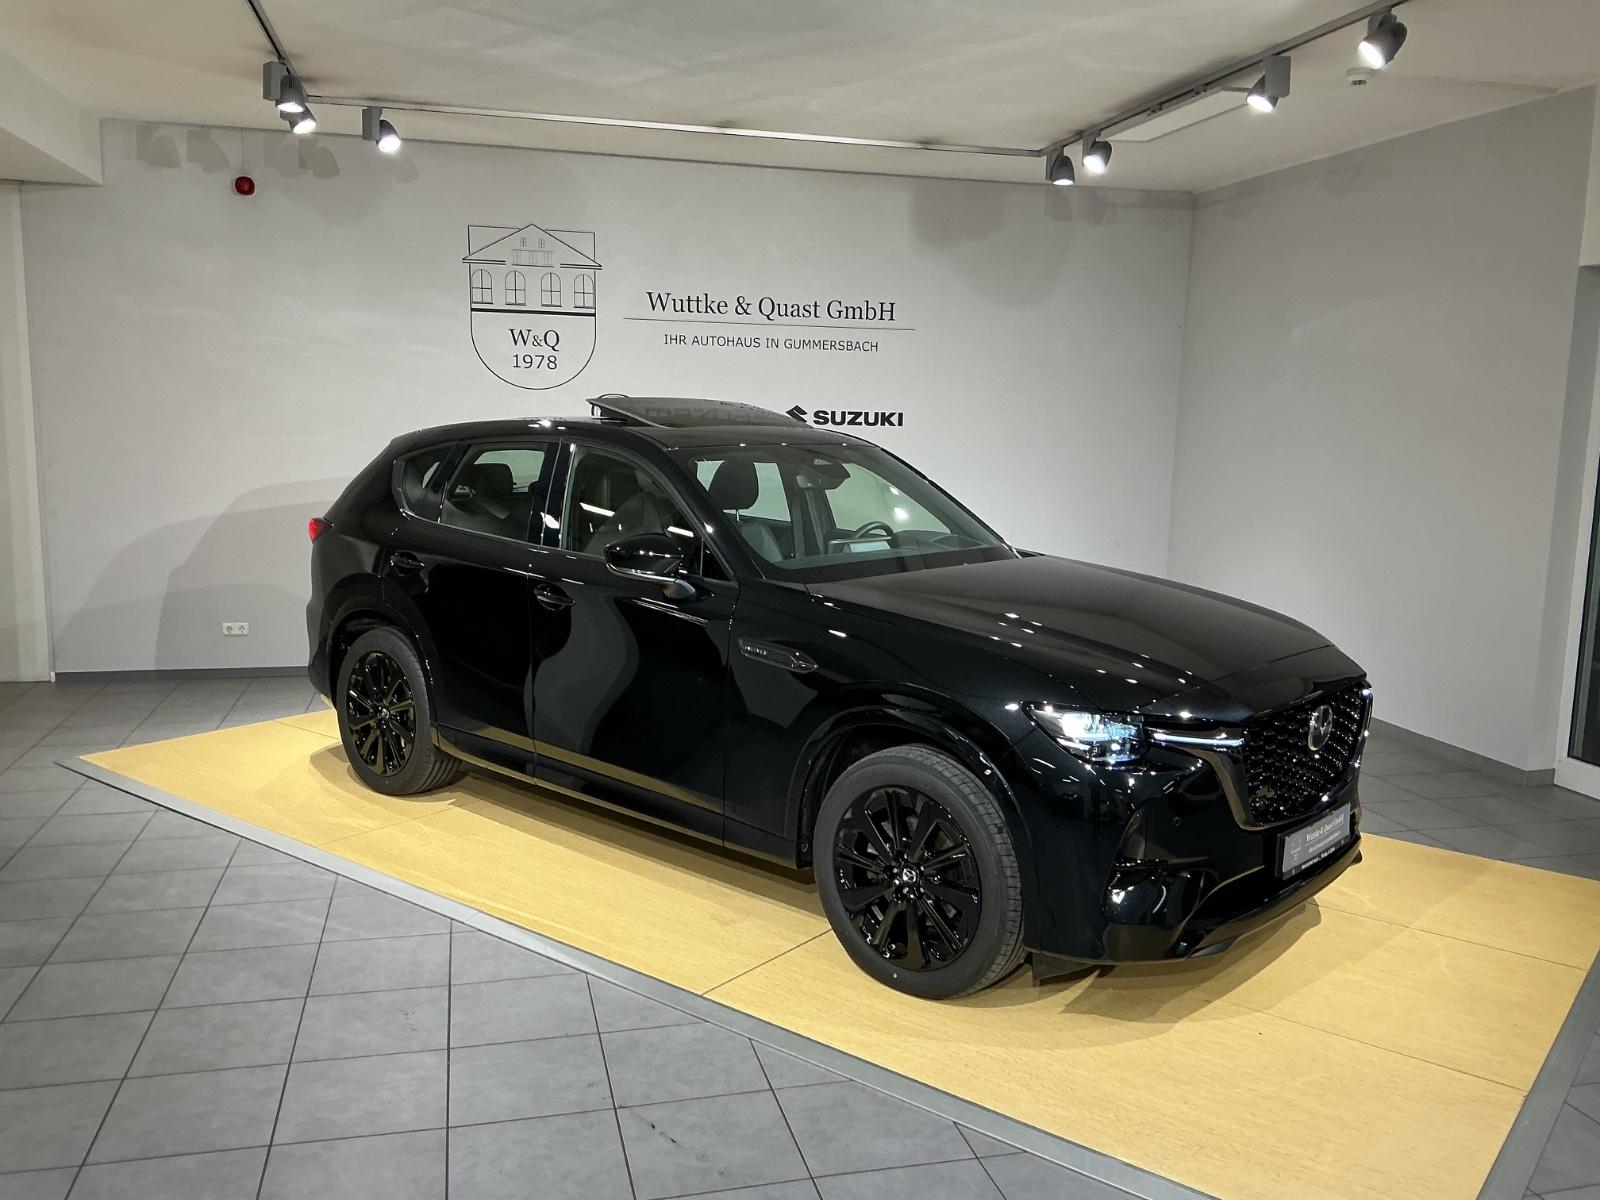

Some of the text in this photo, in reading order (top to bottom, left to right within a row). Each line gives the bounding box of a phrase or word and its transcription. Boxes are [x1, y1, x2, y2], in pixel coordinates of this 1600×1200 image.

[646, 291, 896, 321] Wuttke & Quast GmbH
[508, 328, 560, 352] W&Q
[664, 334, 878, 352] IHR AUTOHAUS IN GUMMERSBACH
[513, 354, 558, 370] 1978
[813, 410, 904, 427] SUZUKI
